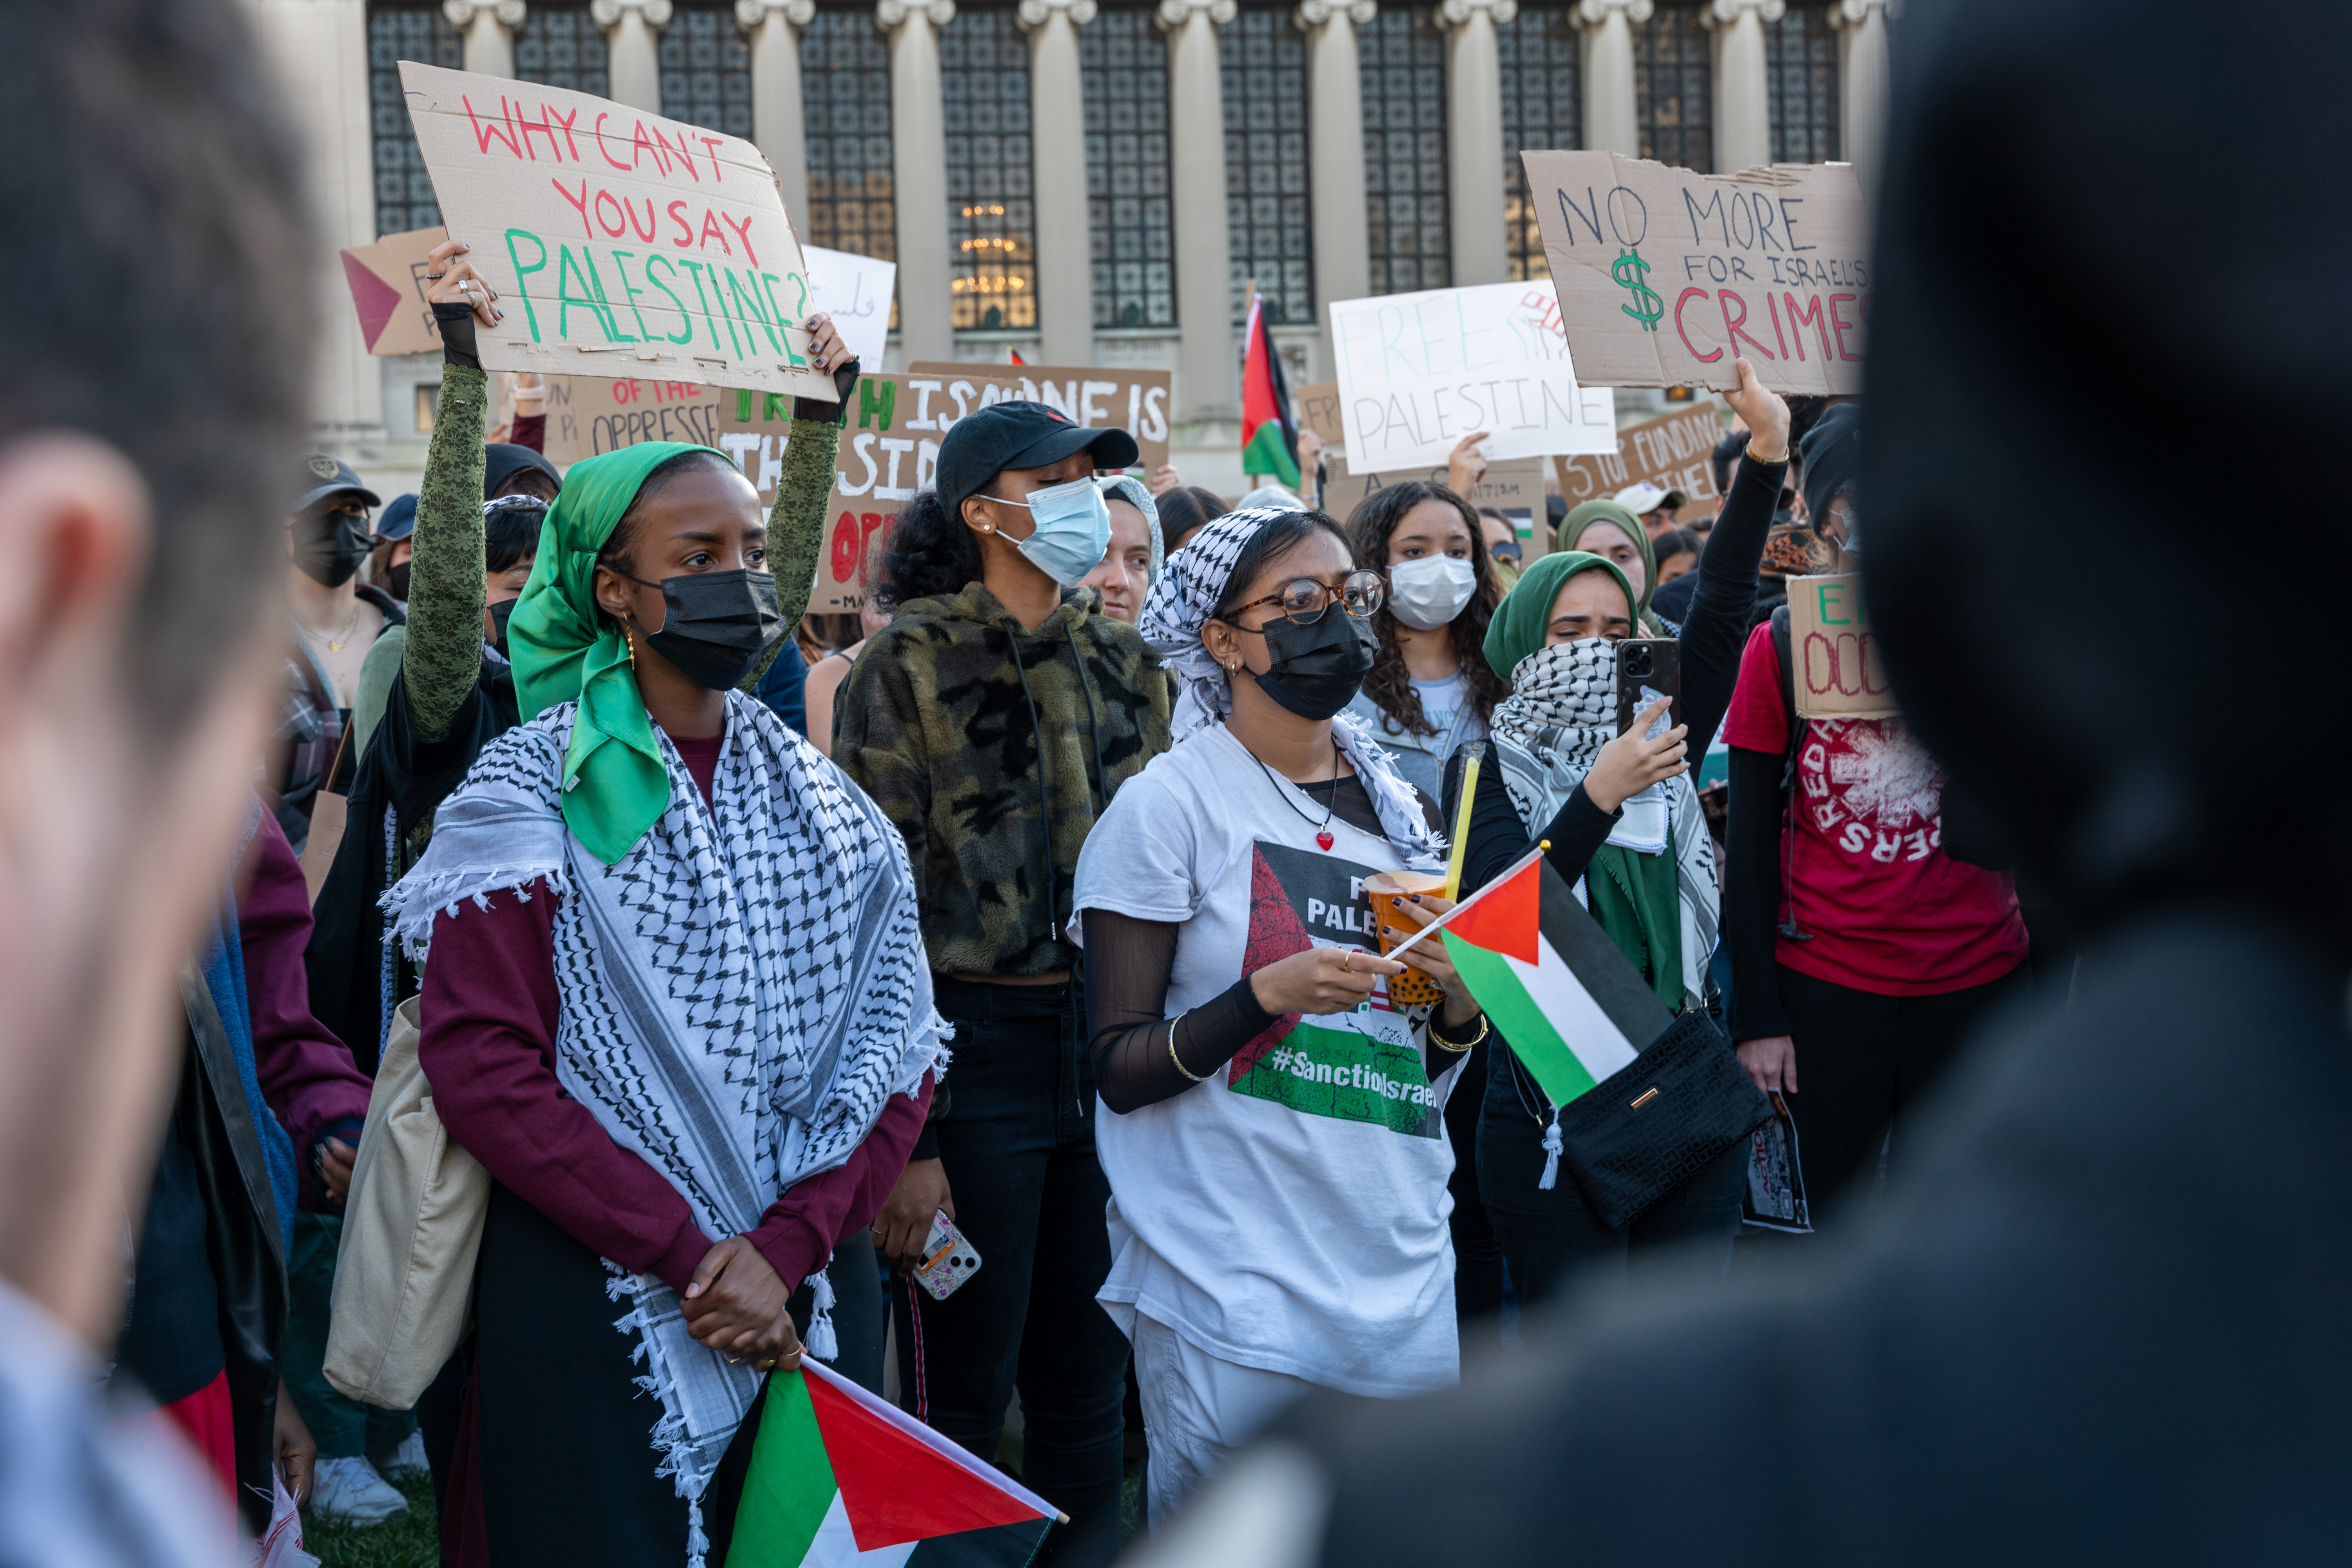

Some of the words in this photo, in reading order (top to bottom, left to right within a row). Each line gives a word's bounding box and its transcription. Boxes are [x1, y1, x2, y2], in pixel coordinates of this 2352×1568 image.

[462, 94, 580, 162] WHY
[595, 112, 723, 183] CAN'T
[552, 178, 656, 244] YOU
[667, 200, 759, 269] SAY
[1557, 186, 1647, 247] NO
[1682, 187, 1817, 252] MORE
[504, 228, 807, 365] PALESTINE?
[1612, 249, 1664, 331] $
[1684, 255, 1755, 282] FOR
[1767, 256, 1868, 287] ISRAEL'S
[1338, 288, 1500, 394] FREE
[612, 379, 642, 405] OF
[906, 379, 977, 434] IS
[1127, 384, 1168, 443] IS
[1354, 378, 1610, 460] PALESTINE
[593, 403, 719, 456] OPPRESSE
[1633, 410, 1725, 474] FUNDING
[1754, 1128, 1769, 1195] ACTIO
